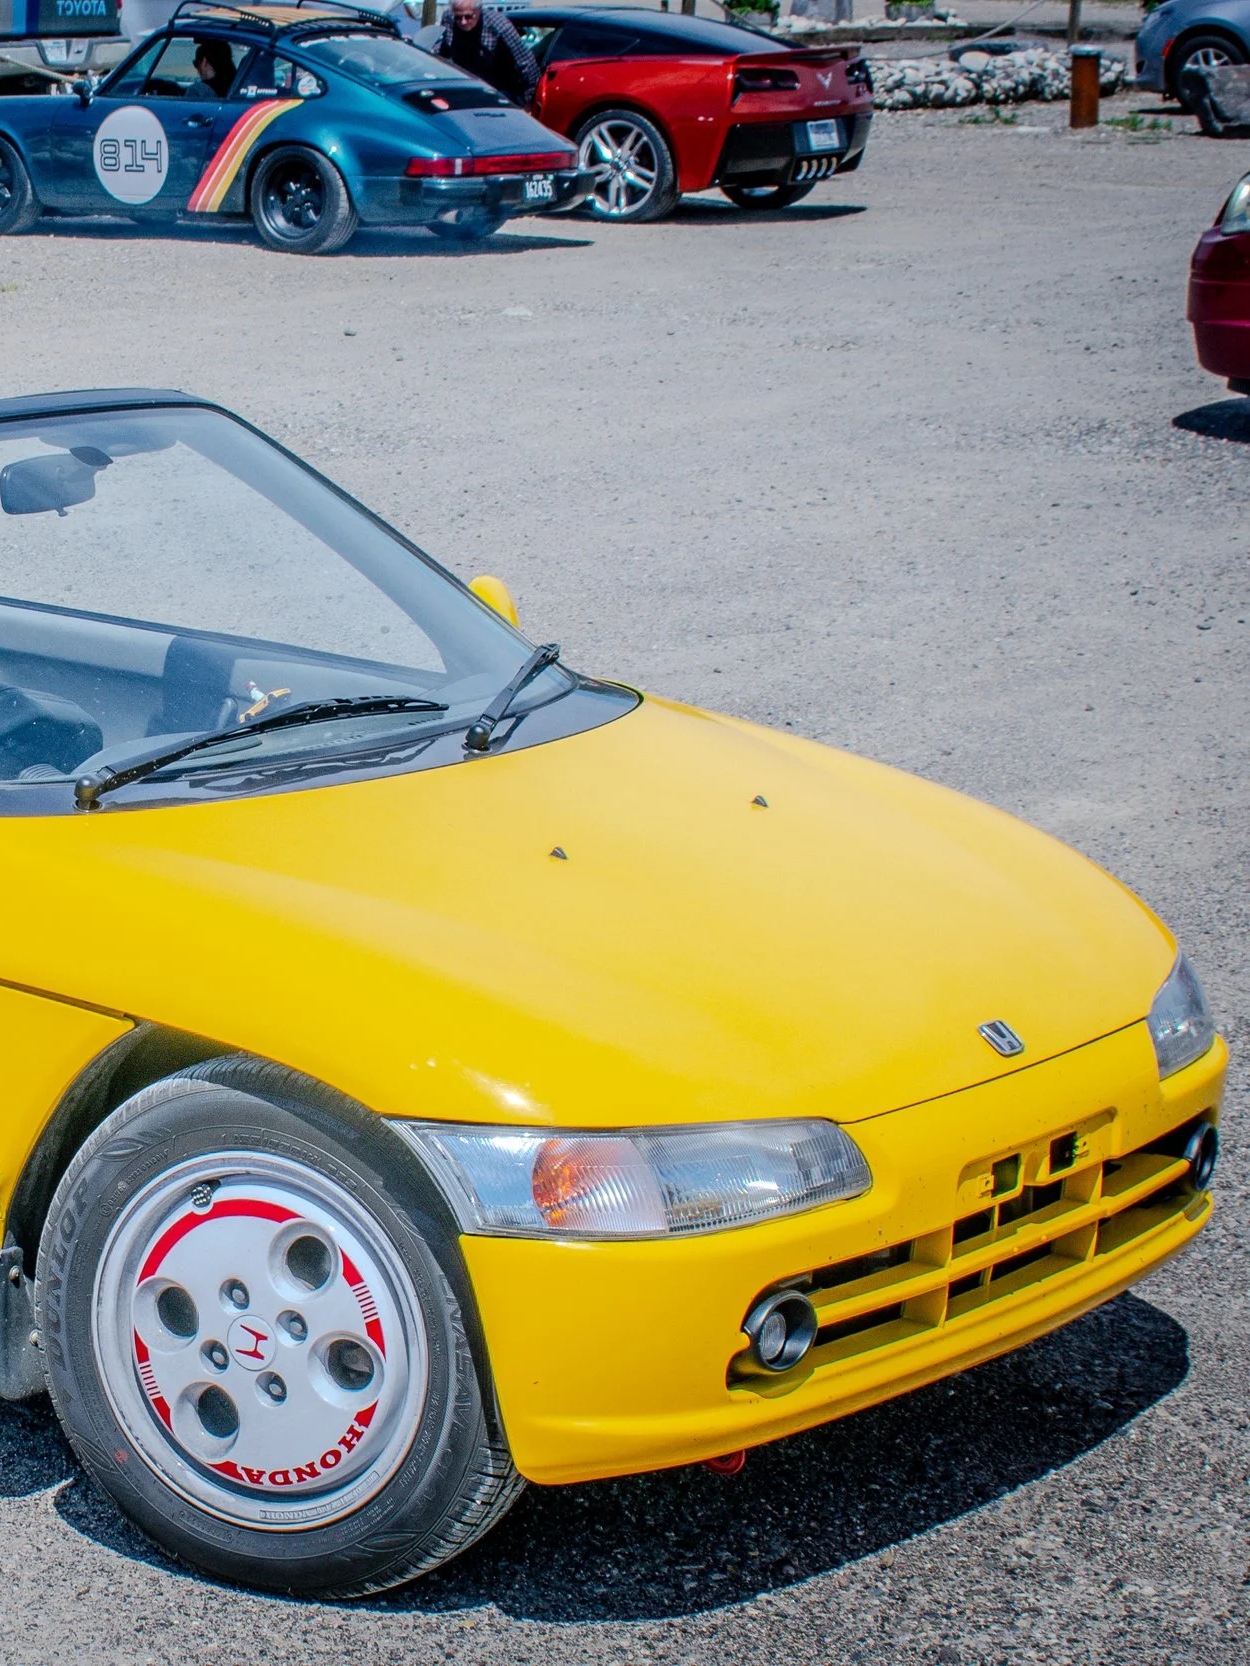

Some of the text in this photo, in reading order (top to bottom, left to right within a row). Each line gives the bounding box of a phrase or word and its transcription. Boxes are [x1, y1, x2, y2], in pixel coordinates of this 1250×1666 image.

[57, 0, 107, 17] TOYOTA
[100, 138, 162, 173] 814
[46, 1176, 89, 1372] DUNLOP
[241, 1425, 365, 1486] HONDA
